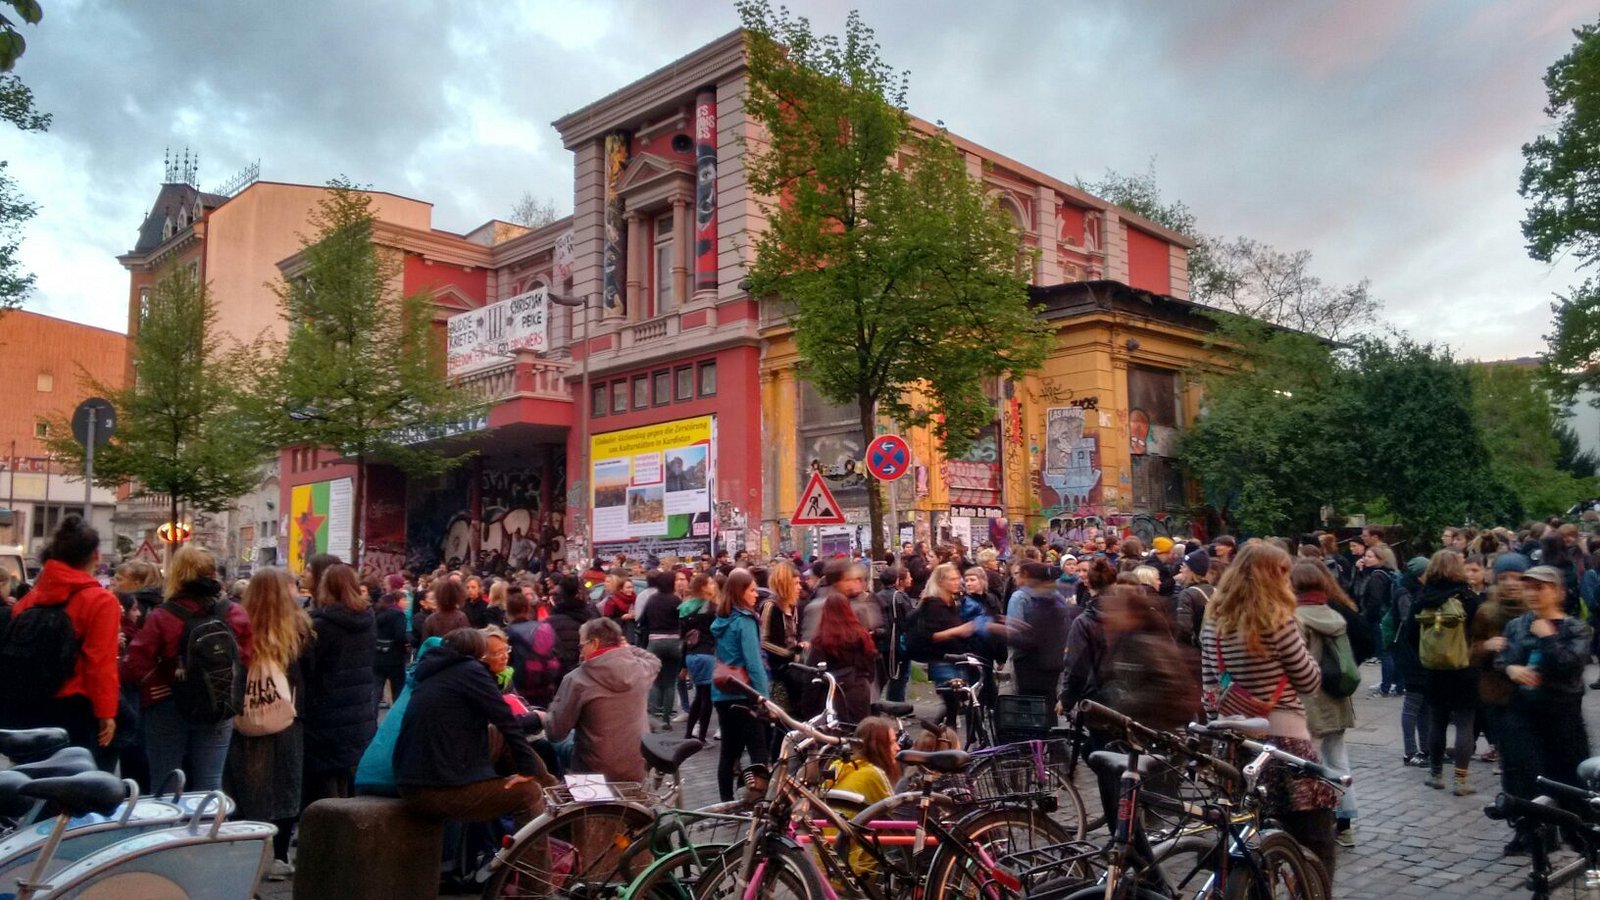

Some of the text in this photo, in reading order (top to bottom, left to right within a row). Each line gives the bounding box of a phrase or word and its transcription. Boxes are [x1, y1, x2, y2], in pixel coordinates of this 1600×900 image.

[510, 293, 543, 314] CHRISTIAN
[647, 430, 664, 439] gegen
[665, 427, 674, 435] die
